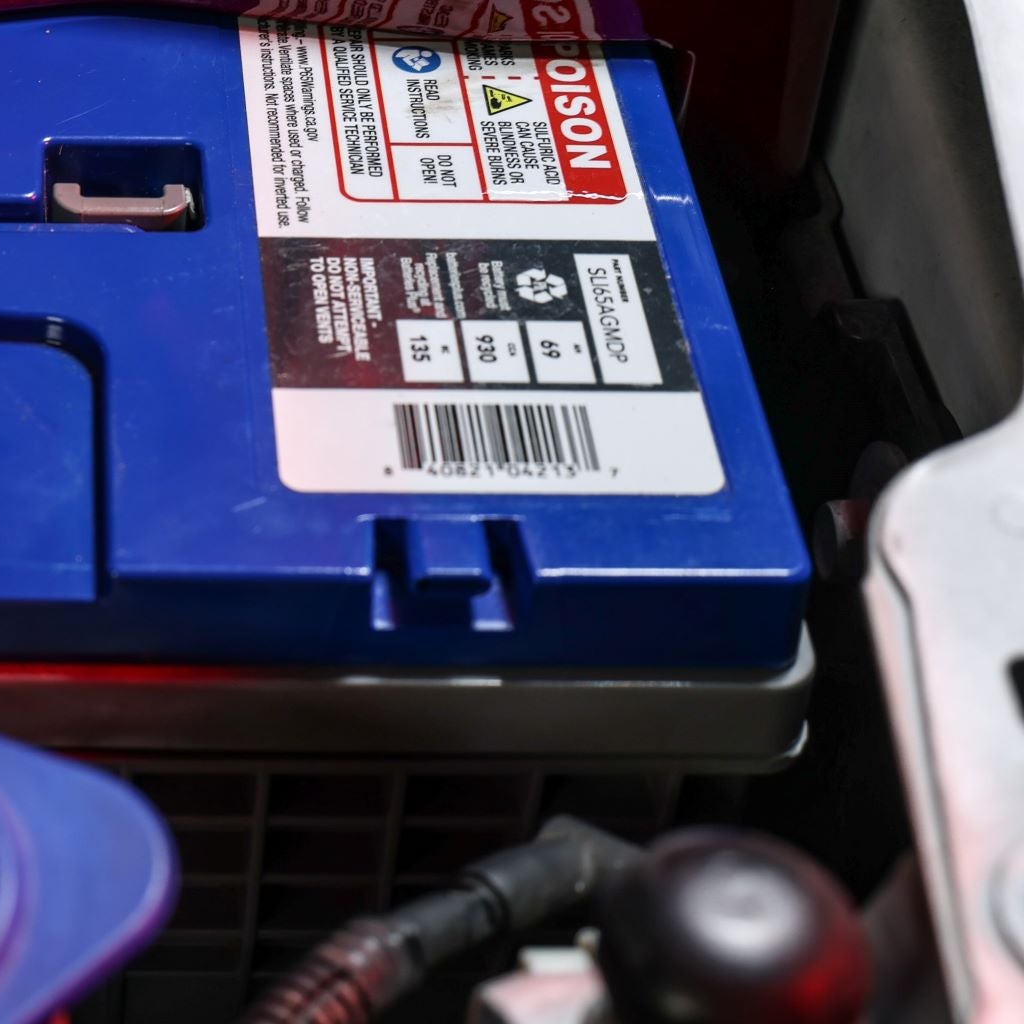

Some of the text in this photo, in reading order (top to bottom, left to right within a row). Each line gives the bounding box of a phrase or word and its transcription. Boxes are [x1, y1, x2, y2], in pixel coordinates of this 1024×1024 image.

[330, 27, 344, 37] BY
[260, 48, 276, 91] instructions.
[333, 47, 351, 86] QUALIFIED
[352, 54, 368, 85] SHOULD
[265, 94, 279, 106] Not
[280, 77, 295, 102] spaces
[296, 46, 318, 142] www.P65Warnings.ca.gov
[340, 88, 357, 122] SERVICE
[357, 88, 372, 110] ONLY
[424, 80, 440, 100] READ
[286, 104, 299, 127] where
[360, 112, 374, 122] BE
[406, 79, 430, 138] INSTRUCTIONS
[266, 108, 286, 162] recommended
[288, 130, 301, 148] used
[344, 125, 364, 175] TECHNICIAN
[363, 125, 383, 177] PERFORMED
[516, 122, 539, 169] CAN CAUSE
[272, 164, 287, 175] for
[291, 150, 302, 158] or
[480, 121, 507, 186] SEVERE BURNS
[498, 122, 524, 184] BLINDNESS OR
[533, 122, 560, 185] SULFURIC ACID
[290, 160, 309, 194] charged.
[420, 158, 438, 184] OPEN!
[438, 155, 456, 187] DO NOT
[274, 177, 292, 209] inverted
[296, 196, 310, 223] Follow
[277, 212, 290, 228] use.
[360, 258, 382, 320] IMPORTANT
[400, 258, 415, 290] Batteries
[414, 263, 432, 306] recycling at
[424, 253, 448, 318] Replacement and
[478, 262, 498, 308] be recycled
[490, 260, 511, 311] Battery must
[612, 259, 628, 302] PART NUMBER
[310, 256, 334, 344] TO OPEN VENTS
[326, 257, 352, 352] DO NOT ATTEMPT
[344, 258, 370, 361] NON-SERVICEABLE
[588, 268, 628, 363] SLI65AGMDP
[410, 335, 430, 362] 135
[476, 335, 497, 363] 930
[508, 343, 516, 356] CCA
[540, 340, 560, 358] 69
